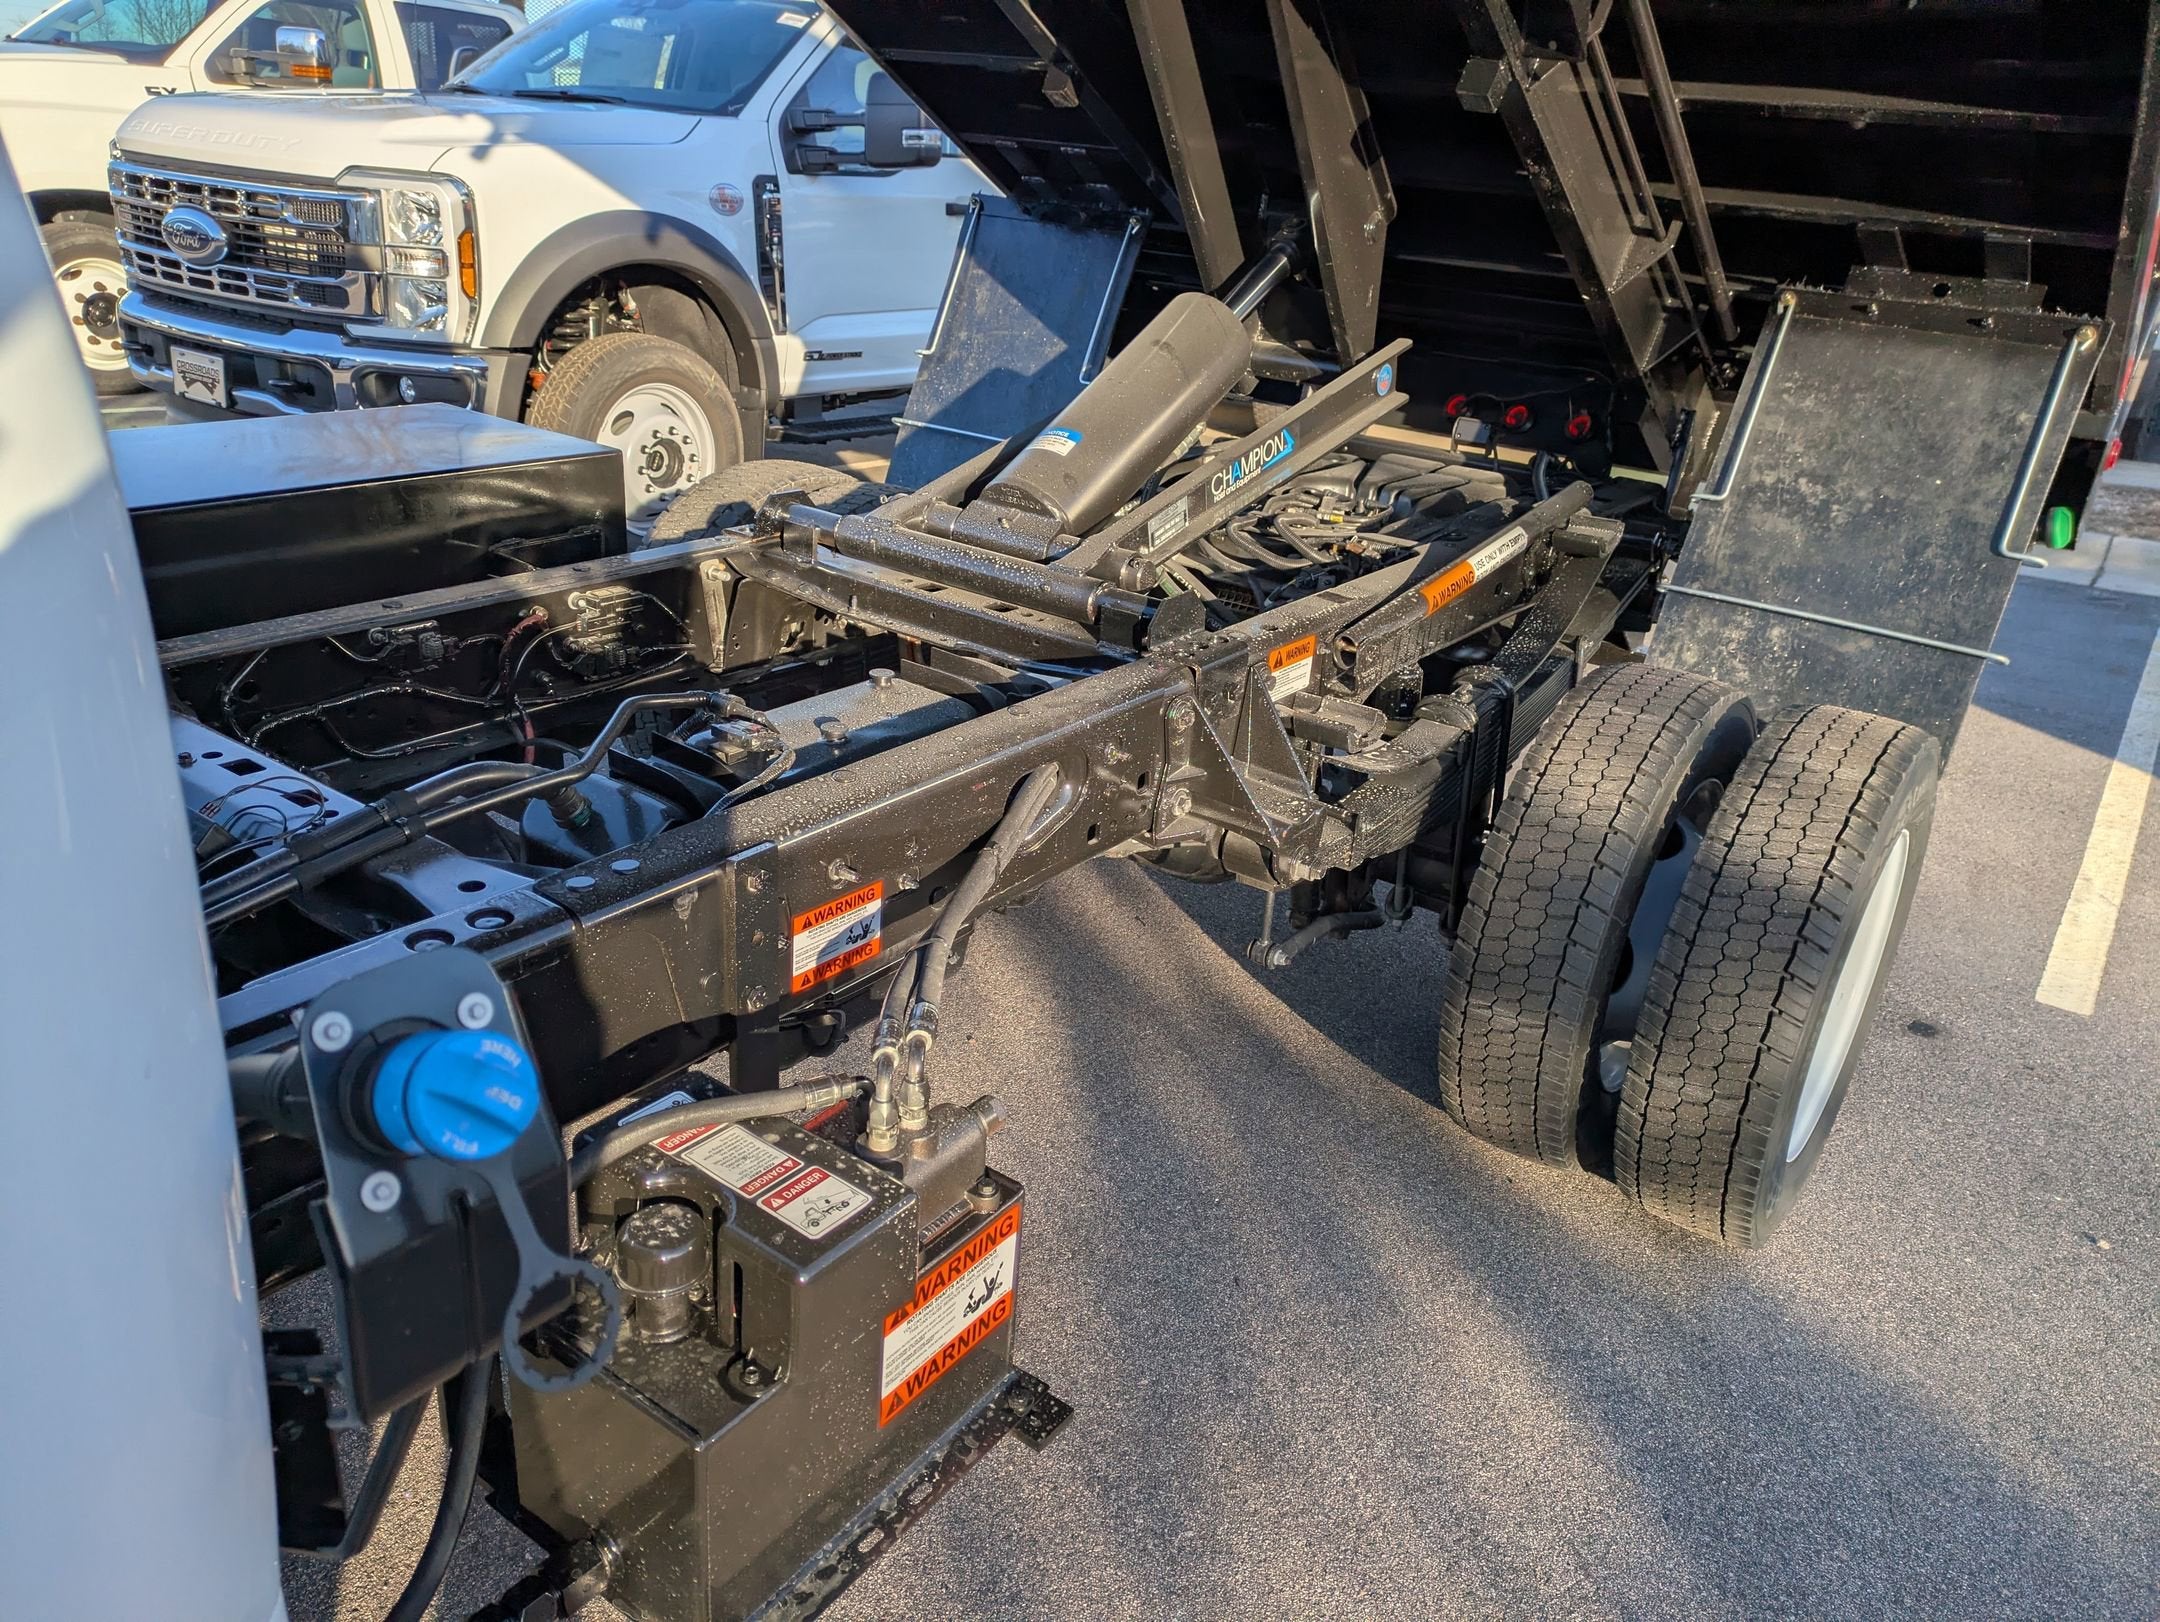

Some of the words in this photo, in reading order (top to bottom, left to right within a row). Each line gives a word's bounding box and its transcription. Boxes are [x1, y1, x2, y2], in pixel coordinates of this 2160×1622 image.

[128, 119, 208, 143] SUPER
[211, 130, 302, 151] DUTY
[172, 222, 201, 248] Ford
[177, 360, 219, 378] CROSSROADS
[1211, 431, 1284, 495] CHAMPION
[1226, 484, 1236, 495] and
[1236, 466, 1261, 488] Equipment
[1438, 571, 1475, 602] WARNING
[1285, 641, 1311, 662] WARNING
[813, 887, 876, 924] WARNING
[812, 943, 873, 981] WARNING
[744, 1165, 786, 1192] DANGER
[782, 1171, 823, 1199] DANGER
[911, 1214, 1014, 1310] WARNING
[905, 1299, 1007, 1399] WARNING
